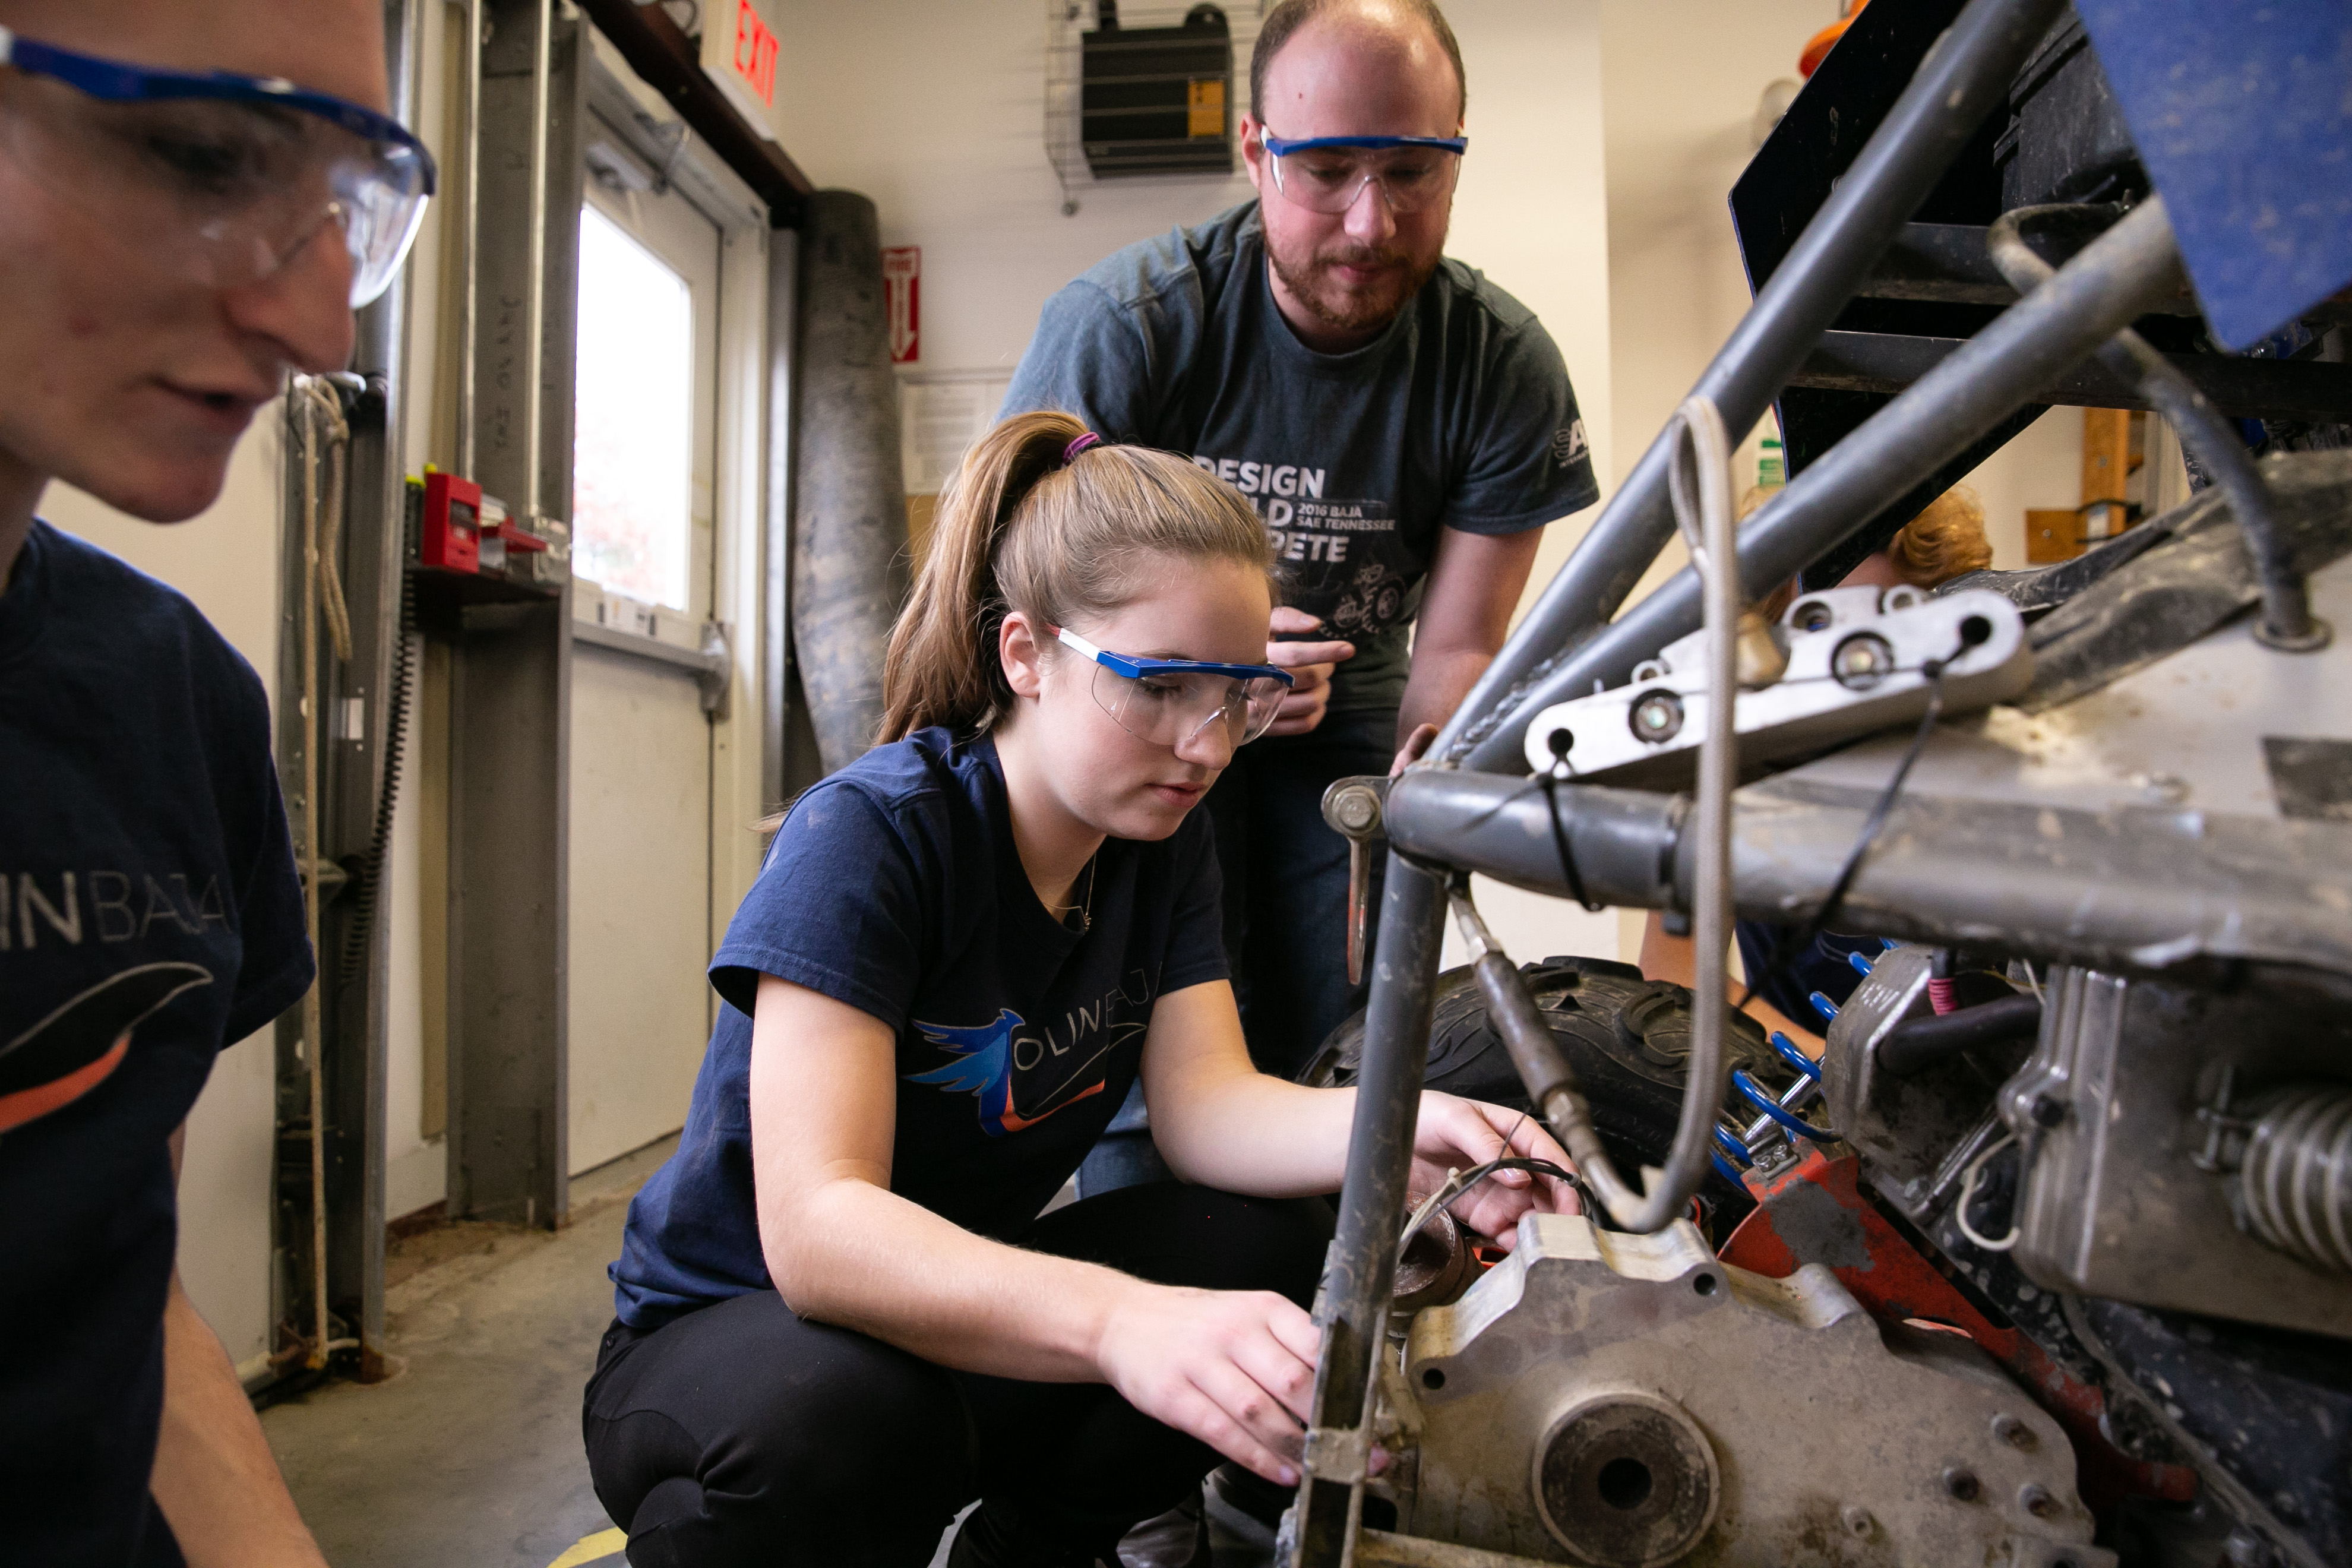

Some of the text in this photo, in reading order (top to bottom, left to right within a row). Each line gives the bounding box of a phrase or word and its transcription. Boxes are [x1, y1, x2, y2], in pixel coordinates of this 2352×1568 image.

[734, 0, 780, 109] EXIT
[1297, 502, 1363, 519] 2016 BAJA
[1325, 517, 1396, 532] TENNESSEE
